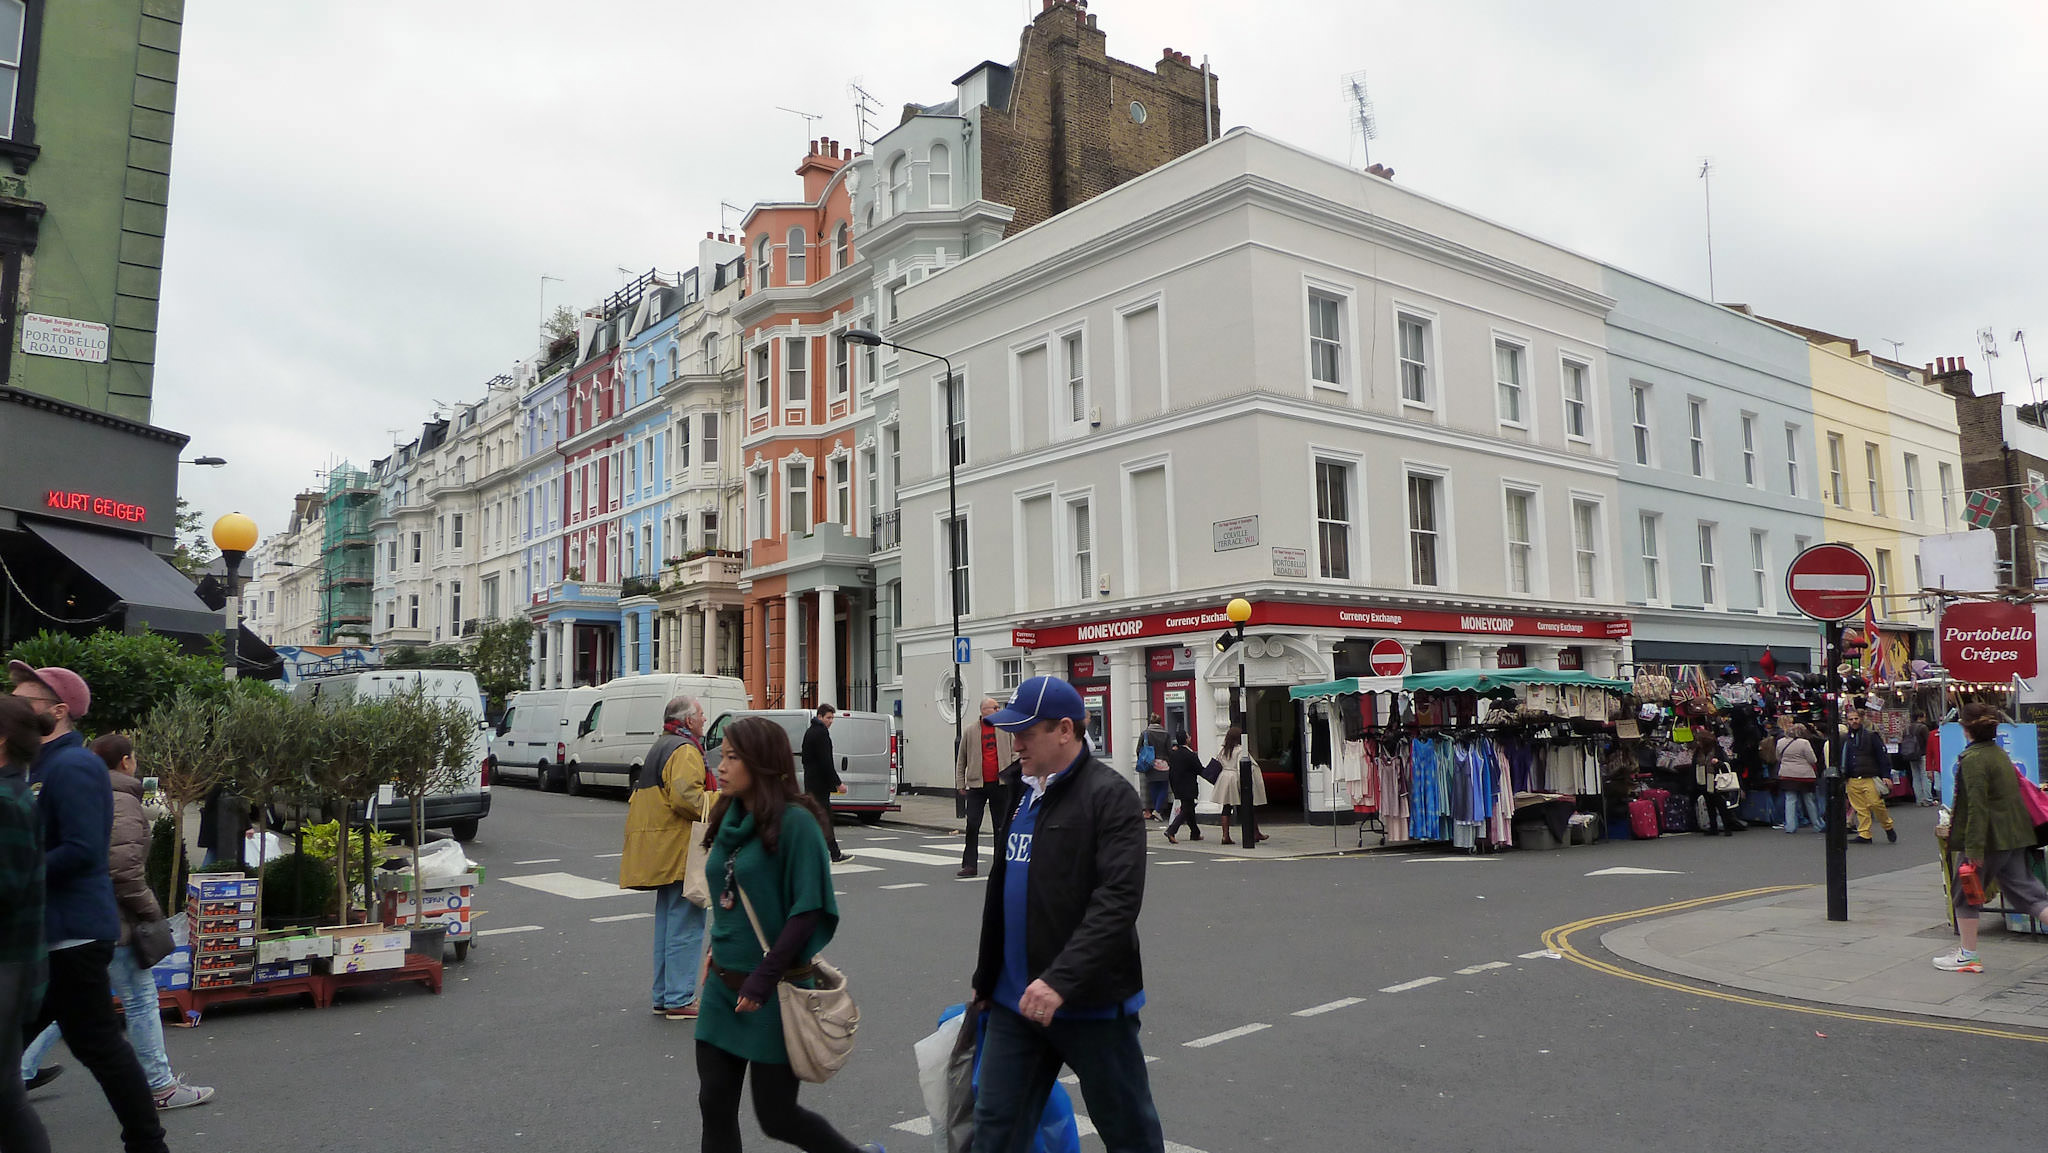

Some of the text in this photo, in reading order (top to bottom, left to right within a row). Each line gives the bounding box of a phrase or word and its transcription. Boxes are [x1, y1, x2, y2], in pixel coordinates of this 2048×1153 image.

[25, 330, 106, 350] PORTOBELLO
[30, 341, 68, 355] ROAD
[48, 490, 146, 522] KURT GEIGER
[1223, 530, 1249, 540] COLVILLE
[1217, 538, 1242, 548] TERRACE
[1273, 559, 1306, 568] PORTOBELLO
[1078, 612, 1232, 641] MONEYCORP Currency Exchan
[1340, 611, 1583, 633] Currency Exchange MONEYCORP Currency Exchange
[1944, 627, 2032, 642] Portobello
[1501, 653, 1519, 666] ATM
[1560, 654, 1576, 666] ATM
[1961, 647, 2018, 663] Crêpes
[1005, 832, 1032, 862] SE
[409, 896, 444, 905] OTSPAN
